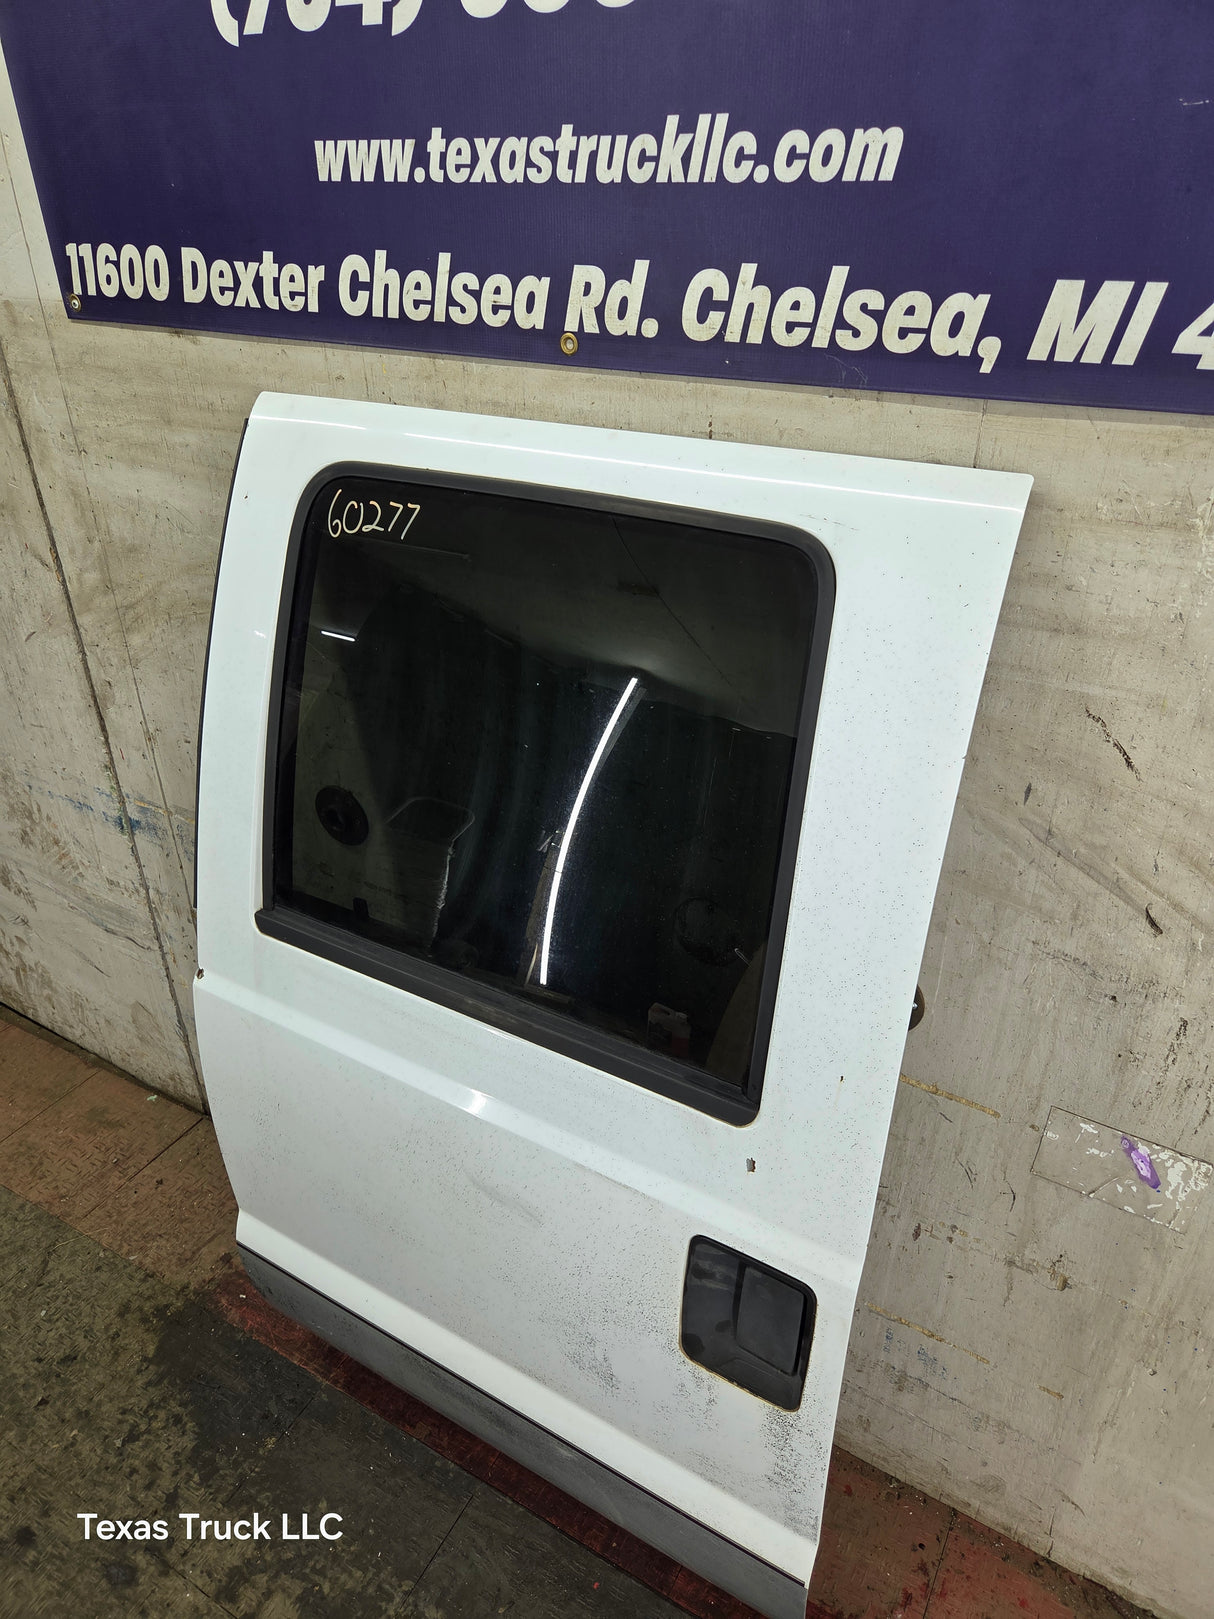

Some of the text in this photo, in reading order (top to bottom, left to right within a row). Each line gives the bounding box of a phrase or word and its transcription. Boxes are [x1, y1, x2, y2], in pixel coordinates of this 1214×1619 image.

[313, 112, 905, 184] www.texastruckllc.com
[65, 242, 170, 302] 11600
[180, 246, 326, 313] Dexter
[338, 249, 551, 330] Chelsea
[563, 258, 659, 339] Rd.
[681, 262, 1002, 374] Chelsea,
[1026, 278, 1170, 366] MI
[327, 488, 421, 540] 60277
